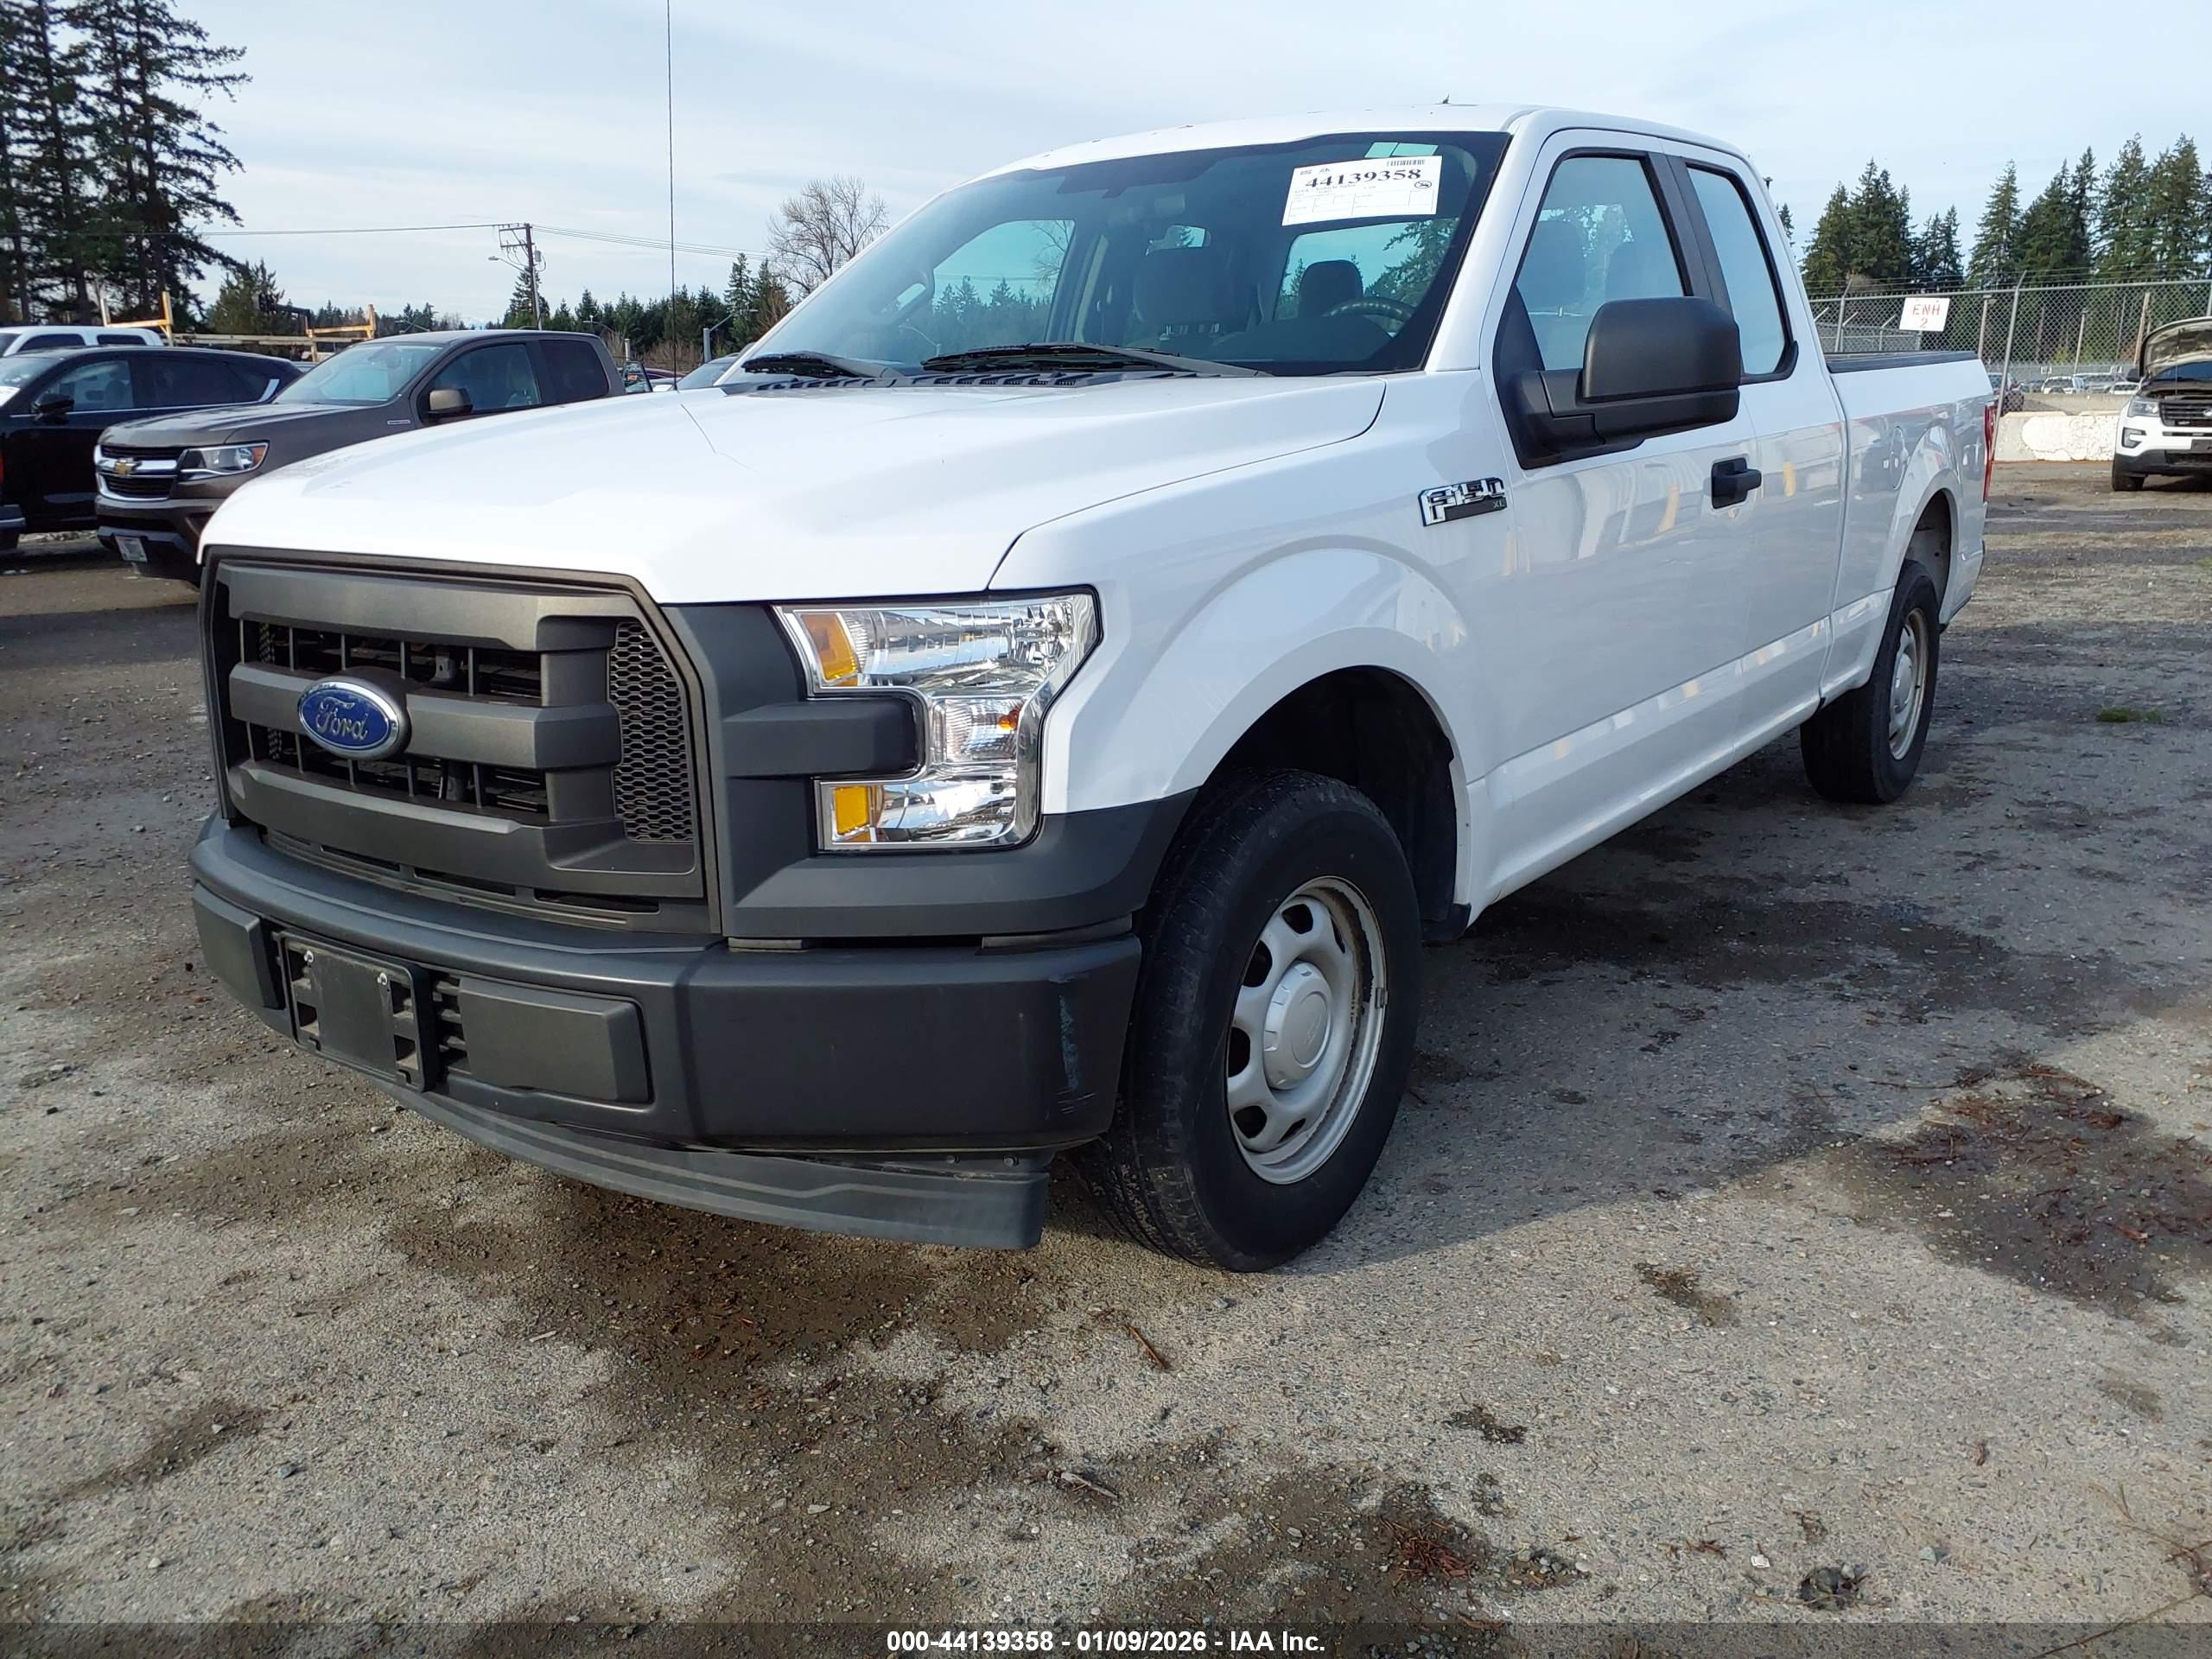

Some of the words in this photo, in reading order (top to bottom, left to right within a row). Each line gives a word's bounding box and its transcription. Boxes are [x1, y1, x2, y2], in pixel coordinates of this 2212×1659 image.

[1306, 168, 1421, 188] 44139358
[1912, 303, 1941, 316] ENH
[1920, 317, 1929, 329] 2
[1493, 499, 1505, 509] XL
[315, 696, 369, 741] Ford
